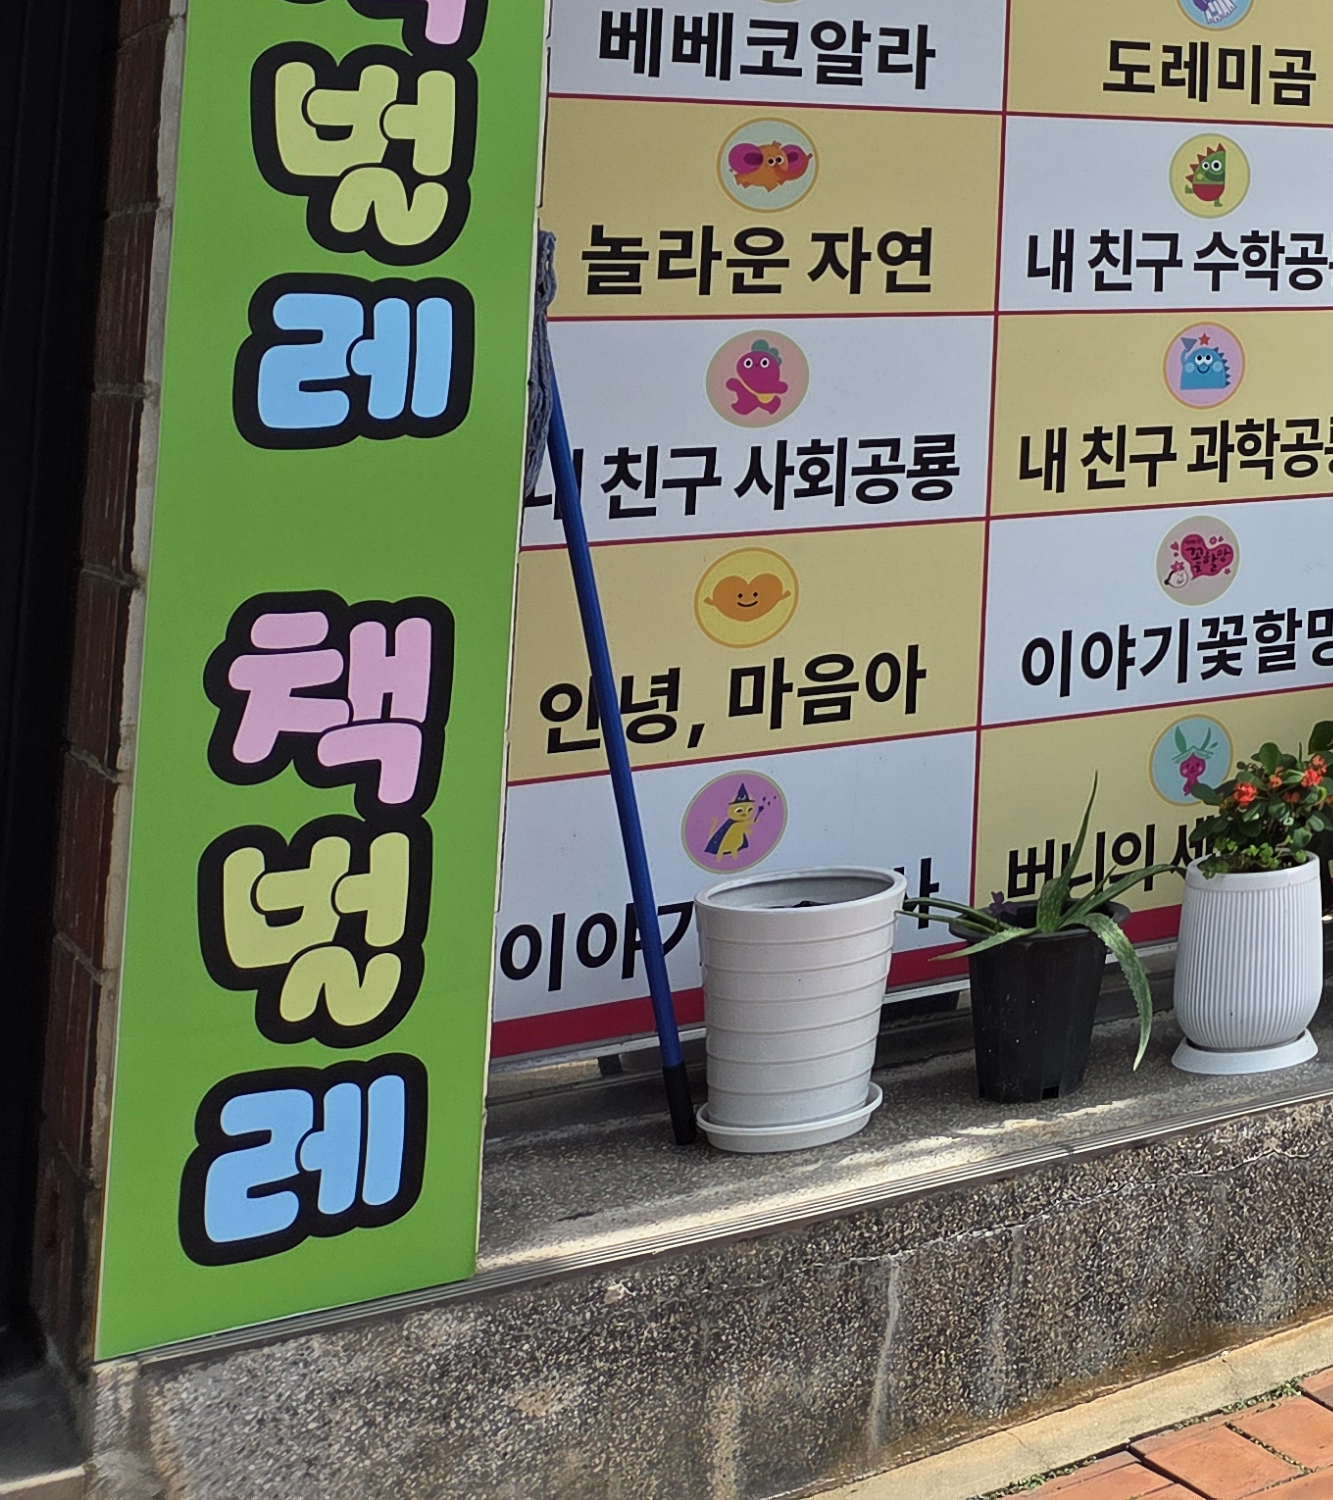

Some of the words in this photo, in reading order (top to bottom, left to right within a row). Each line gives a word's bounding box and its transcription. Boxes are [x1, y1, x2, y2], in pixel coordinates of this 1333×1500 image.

[598, 7, 937, 90] 베베코알라
[1102, 40, 1317, 106] 도레미곰
[580, 223, 791, 296] 놀라운
[807, 225, 934, 294] 자연
[1026, 228, 1075, 293] 내
[1086, 228, 1184, 292] 친구
[601, 443, 722, 519] 친구
[733, 433, 961, 508] 사회공룡
[1018, 427, 1067, 493] 내
[1079, 423, 1178, 489] 친구
[539, 667, 705, 754] 안녕,
[727, 644, 926, 730] 마음아
[178, 590, 454, 1267] 책벌레
